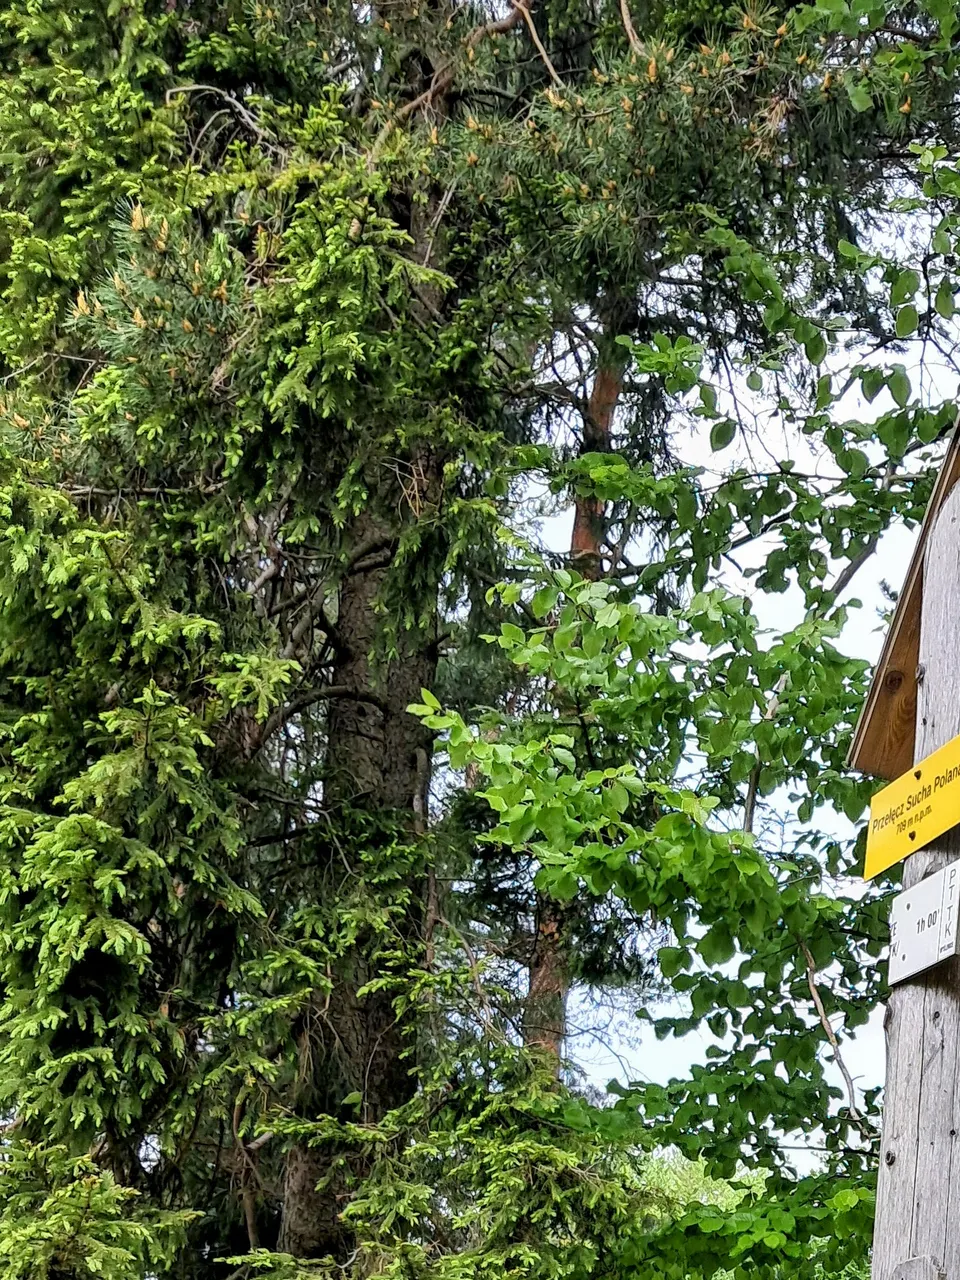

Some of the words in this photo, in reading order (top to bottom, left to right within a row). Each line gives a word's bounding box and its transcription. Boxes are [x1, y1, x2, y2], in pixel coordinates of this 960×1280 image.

[872, 801, 905, 834] Przełęcz
[906, 785, 932, 812] Sucha
[917, 917, 925, 934] 1h
[945, 869, 956, 938] PTTK
